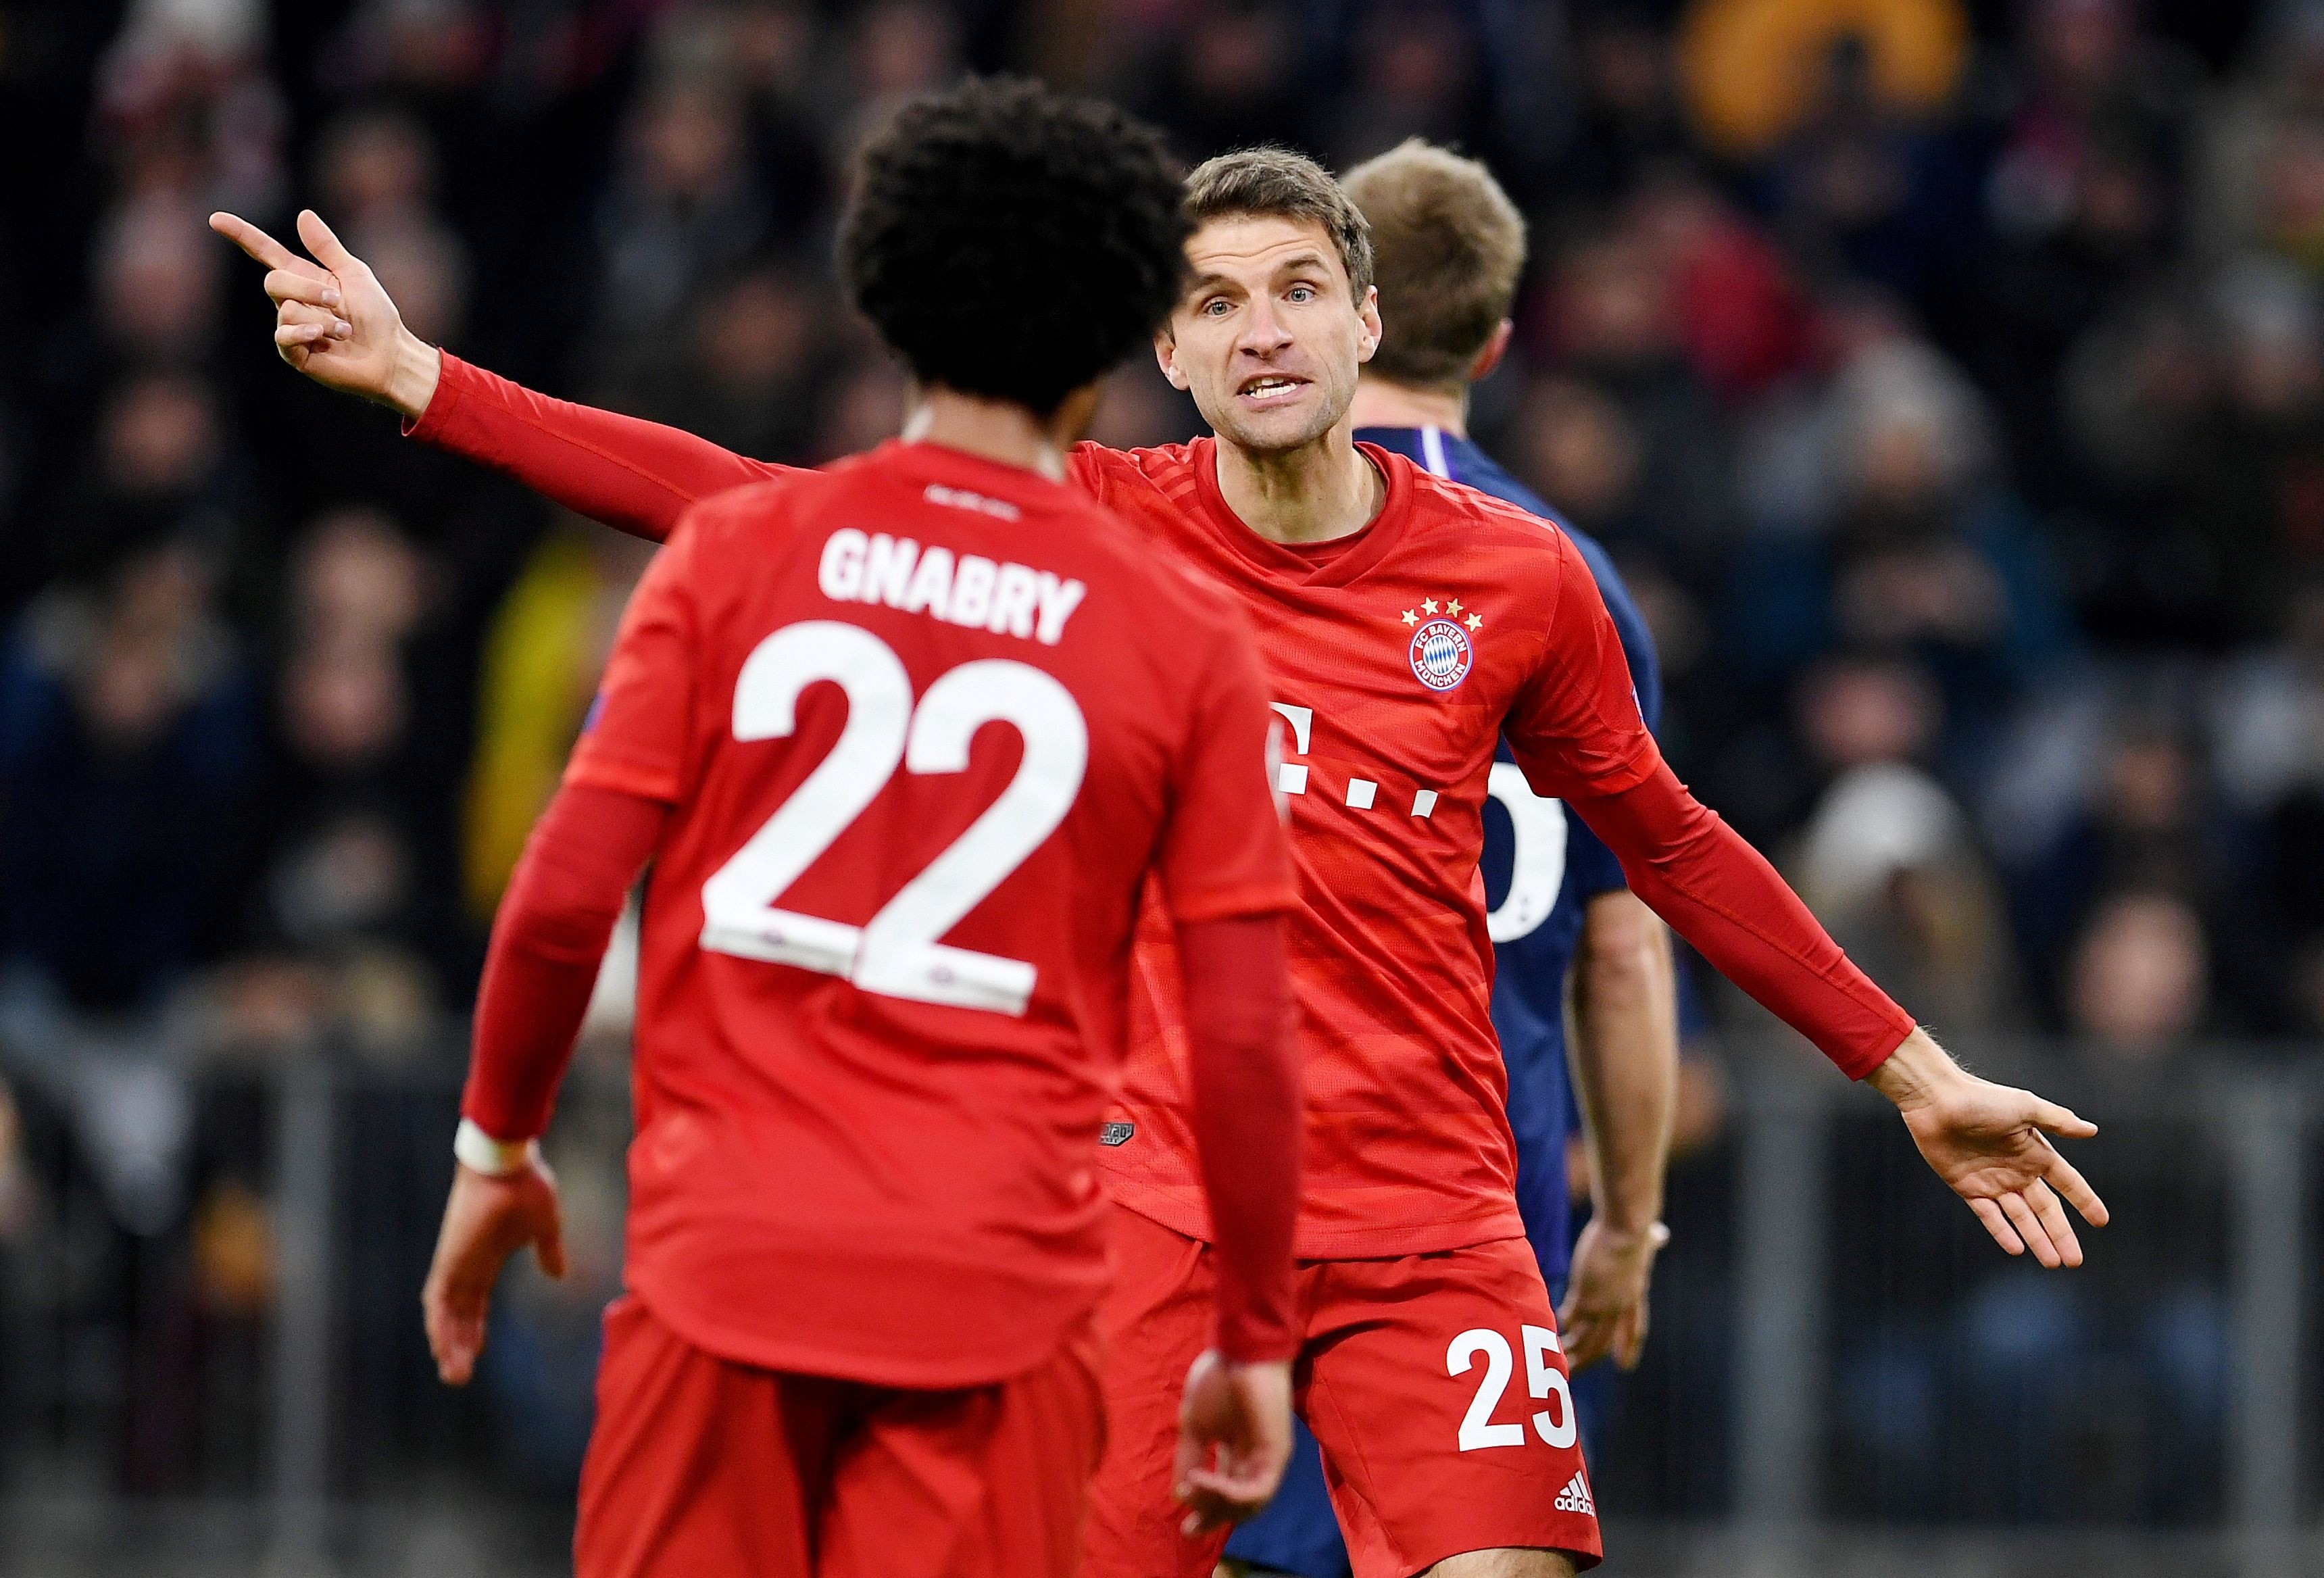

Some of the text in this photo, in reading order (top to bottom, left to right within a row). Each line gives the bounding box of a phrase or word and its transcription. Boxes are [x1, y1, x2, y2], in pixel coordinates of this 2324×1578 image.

[817, 527, 1087, 645] GNABRY
[1415, 624, 1467, 653] FC BAYERN
[699, 620, 1089, 1016] 22
[1446, 1325, 1577, 1452] 25
